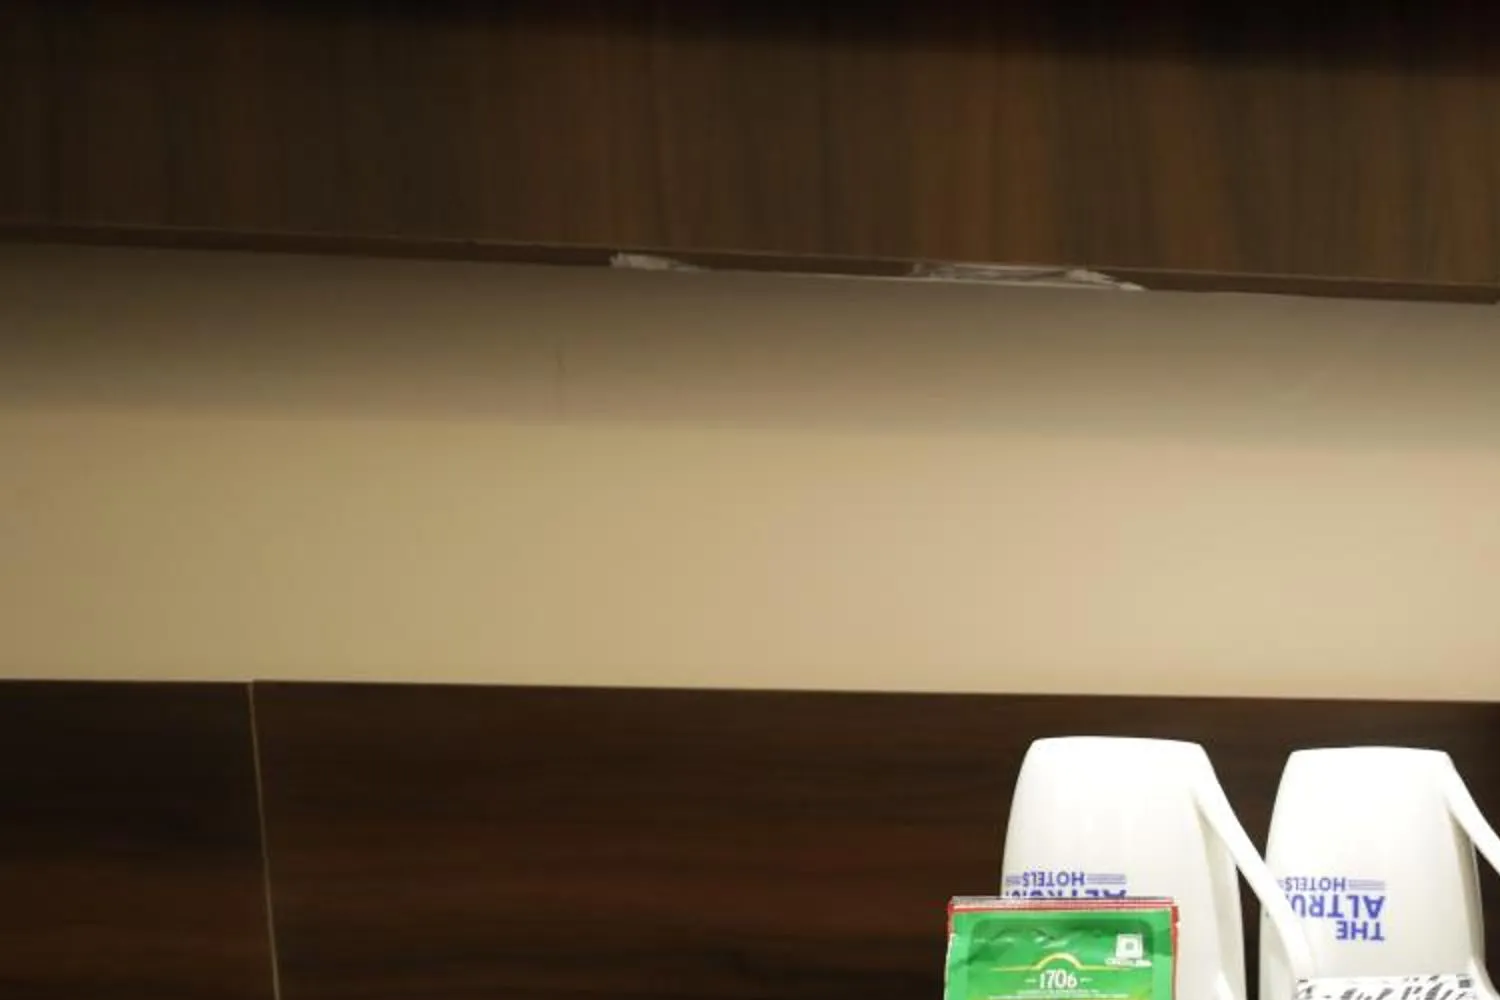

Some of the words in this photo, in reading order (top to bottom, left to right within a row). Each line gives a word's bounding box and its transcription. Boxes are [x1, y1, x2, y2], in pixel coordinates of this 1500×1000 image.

[1022, 871, 1085, 887] HOTELS
[1284, 877, 1347, 892] HOTELS
[1284, 894, 1386, 919] ALTRU
[1335, 920, 1386, 941] THE
[1039, 969, 1078, 989] 1706
